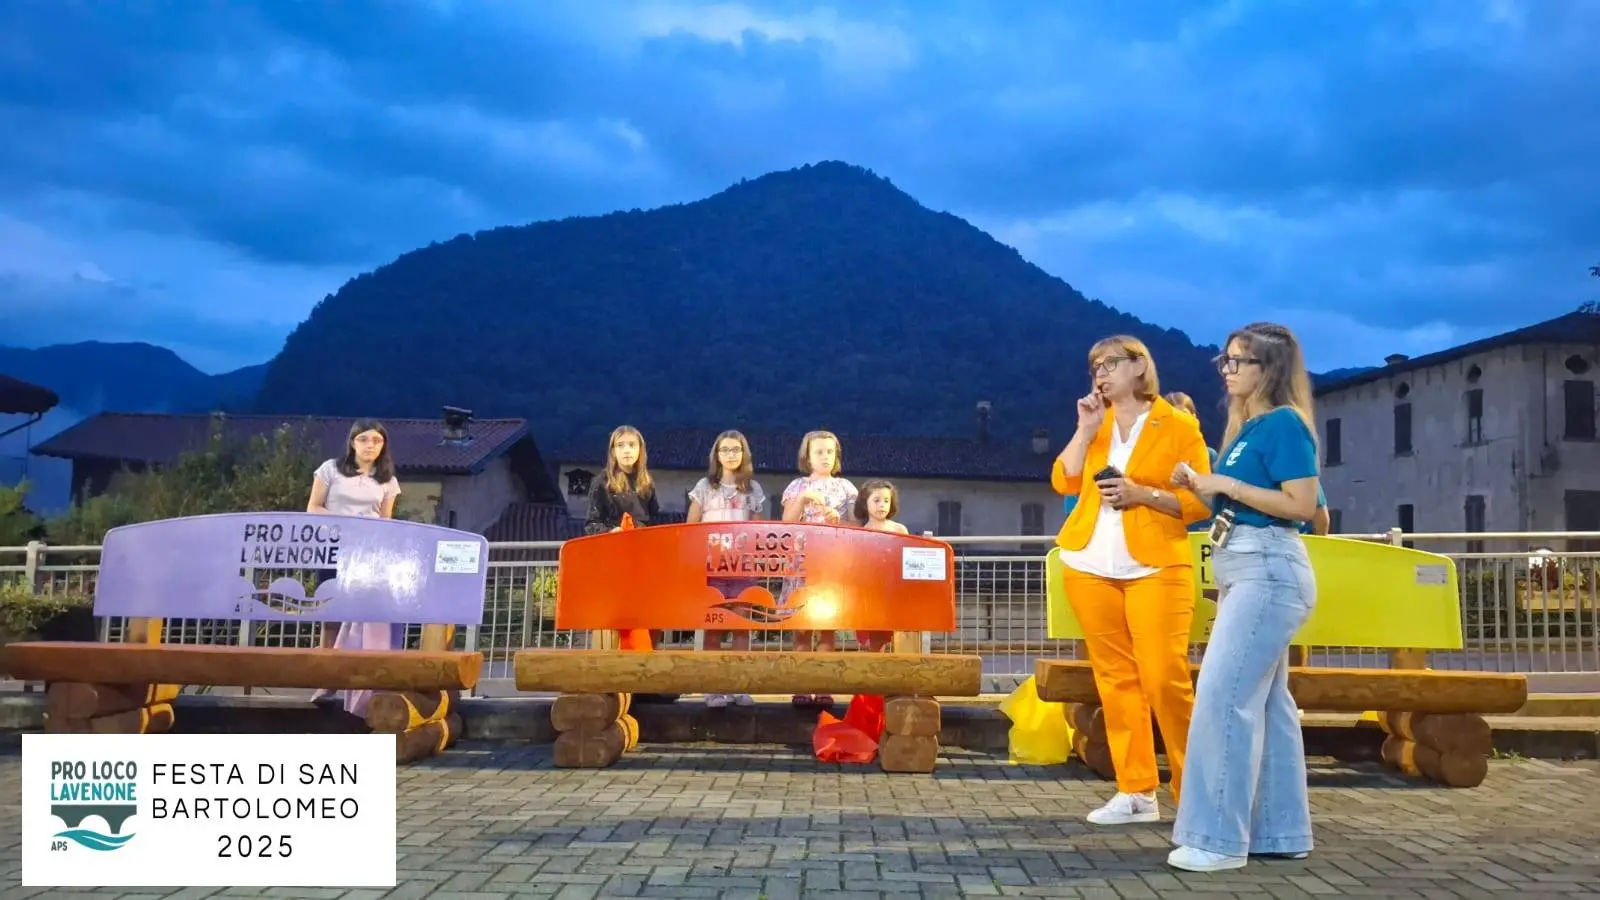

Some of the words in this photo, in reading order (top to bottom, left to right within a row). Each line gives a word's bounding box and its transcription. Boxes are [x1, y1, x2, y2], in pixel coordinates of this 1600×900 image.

[244, 523, 284, 544] PRO
[290, 524, 341, 544] LOCO
[706, 532, 748, 552] PRO
[755, 532, 807, 552] LOCO
[240, 546, 339, 565] LAVENONE
[706, 554, 806, 574] LAVENONE
[704, 613, 724, 625] APS
